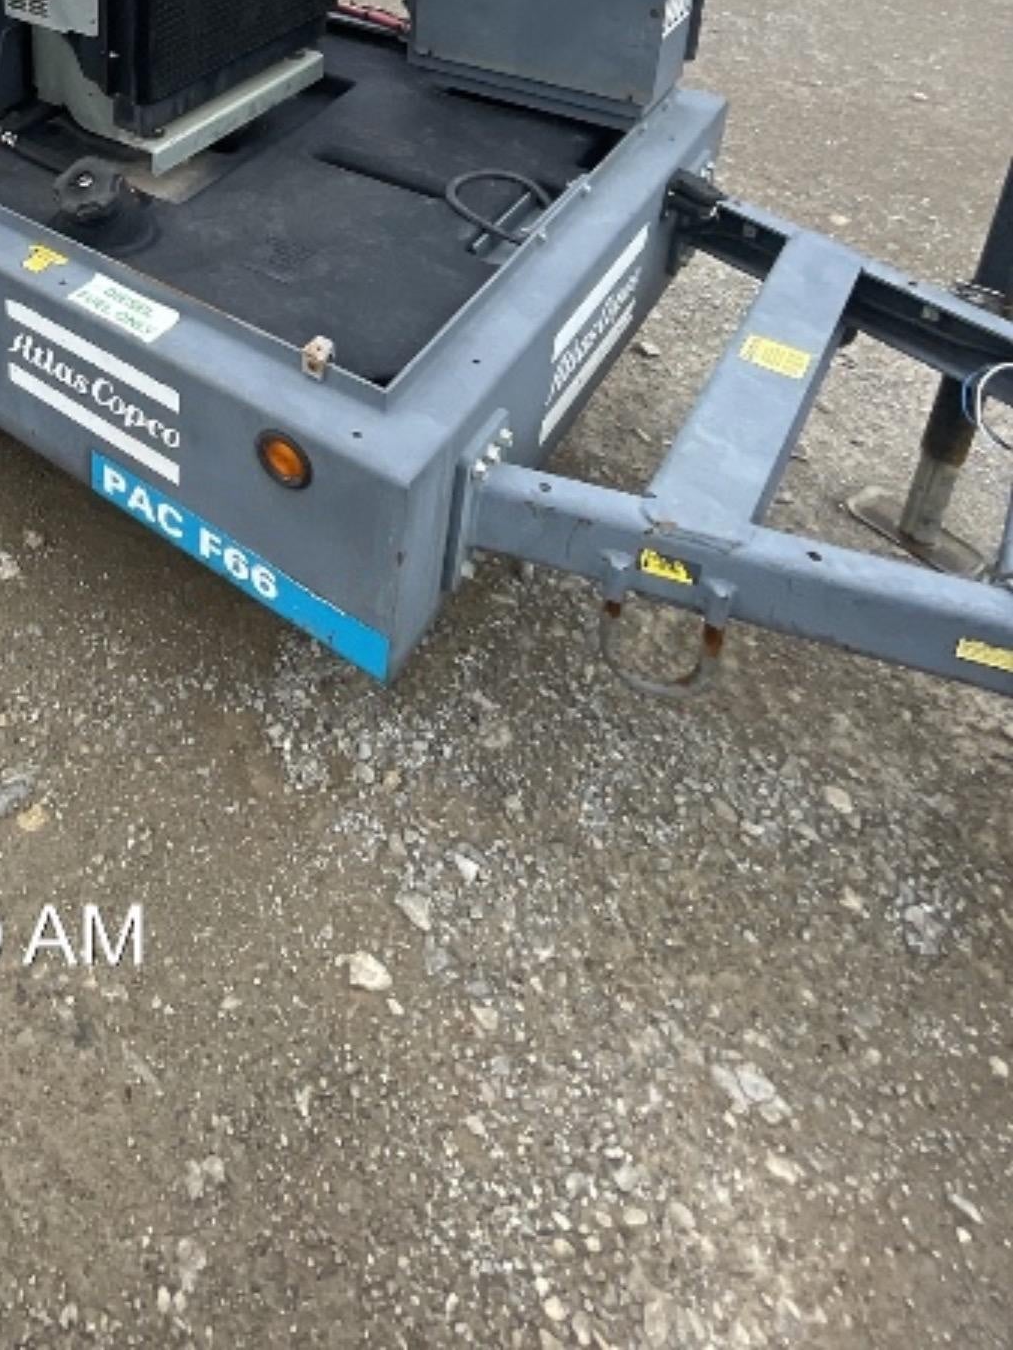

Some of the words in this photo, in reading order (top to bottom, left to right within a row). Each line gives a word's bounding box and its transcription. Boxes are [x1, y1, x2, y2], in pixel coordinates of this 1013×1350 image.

[8, 333, 89, 394] Atlas
[92, 377, 180, 448] Copco
[103, 464, 183, 538] PAC
[199, 527, 278, 600] F66
